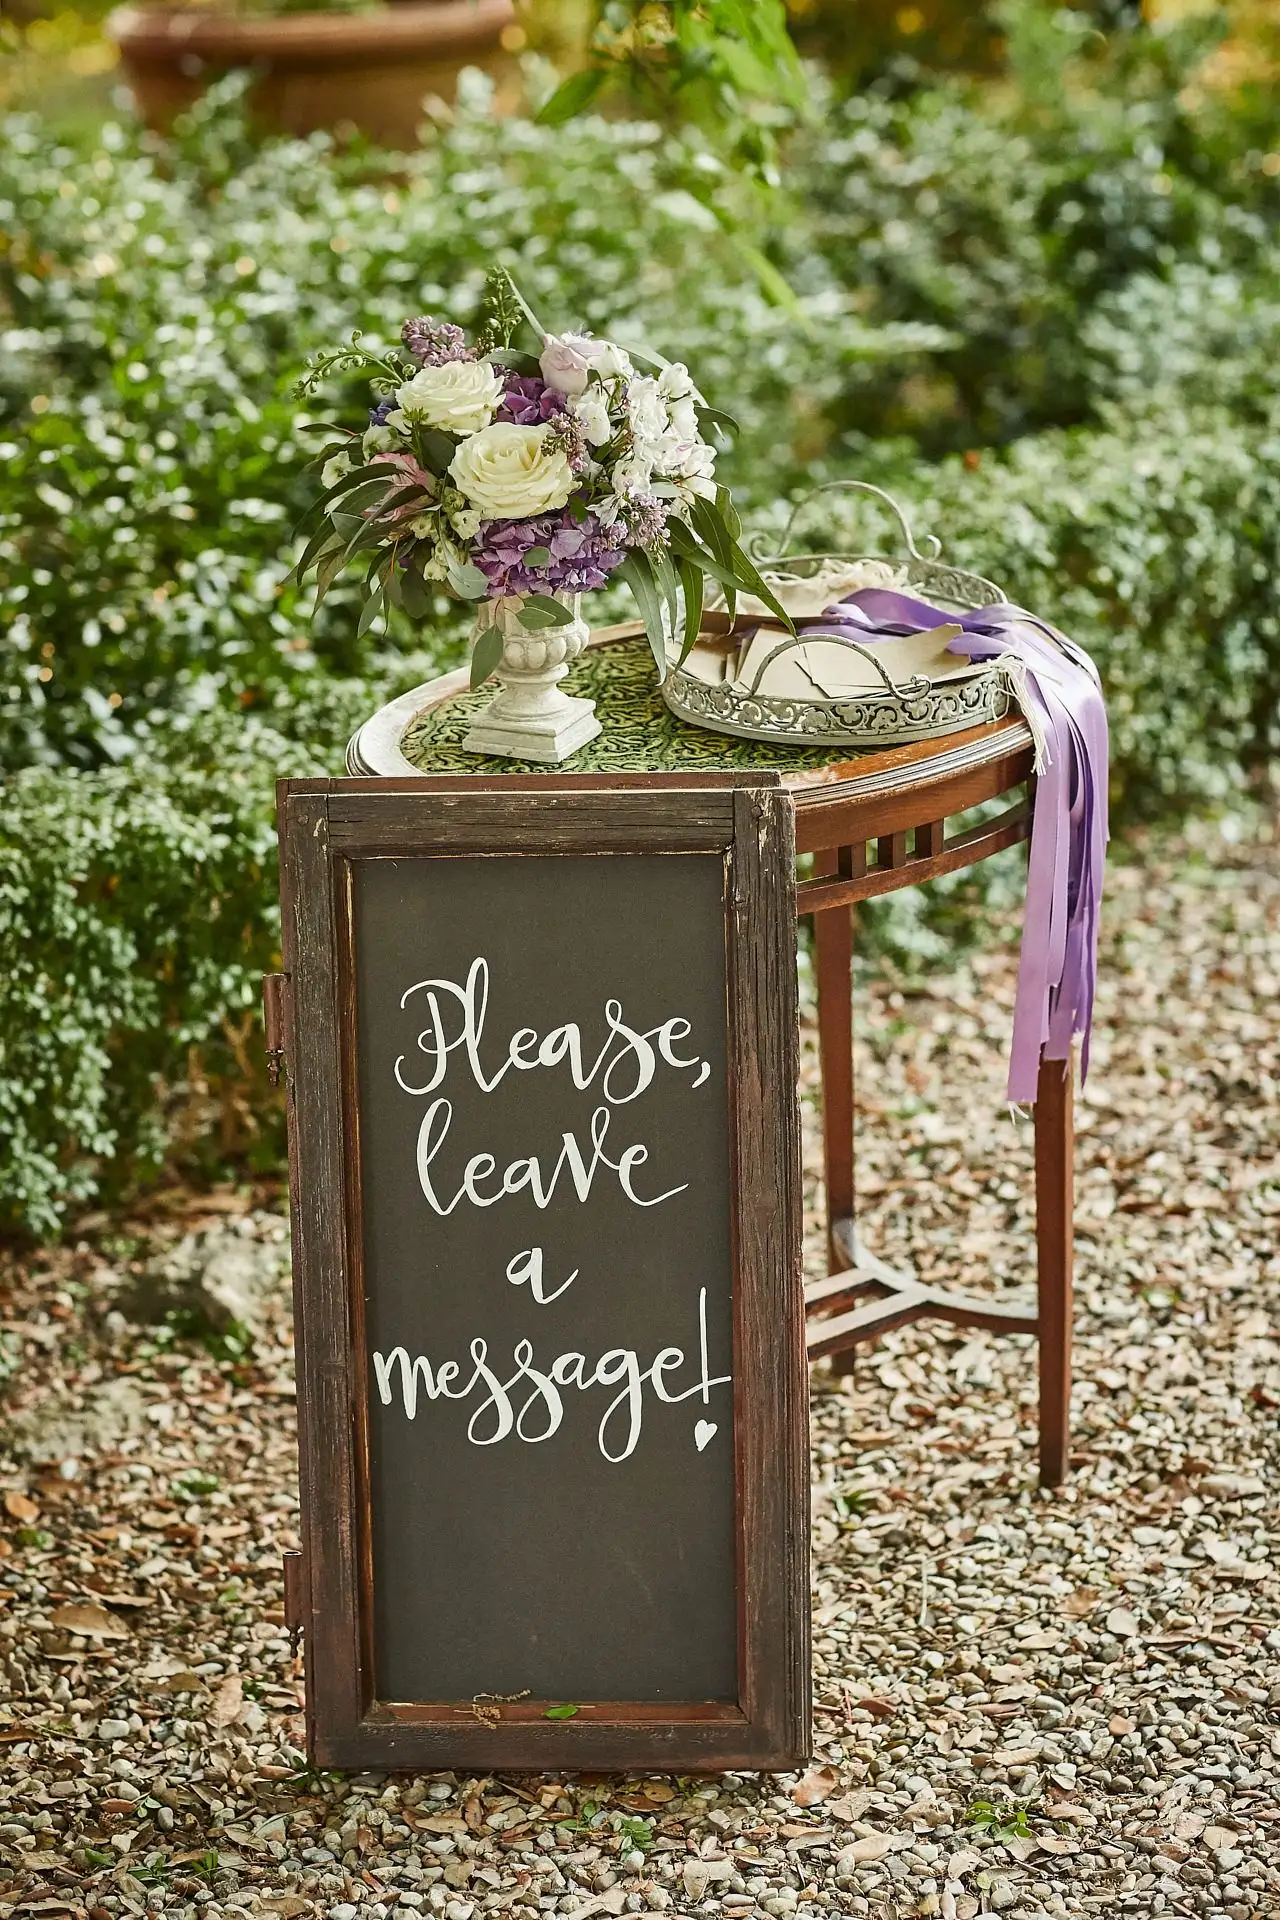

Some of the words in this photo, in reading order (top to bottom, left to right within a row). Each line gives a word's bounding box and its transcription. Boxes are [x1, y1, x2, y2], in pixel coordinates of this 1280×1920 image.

[394, 957, 711, 1105] Please,
[416, 1097, 690, 1216] leave
[506, 1247, 579, 1305] a
[373, 1286, 732, 1463] message!
